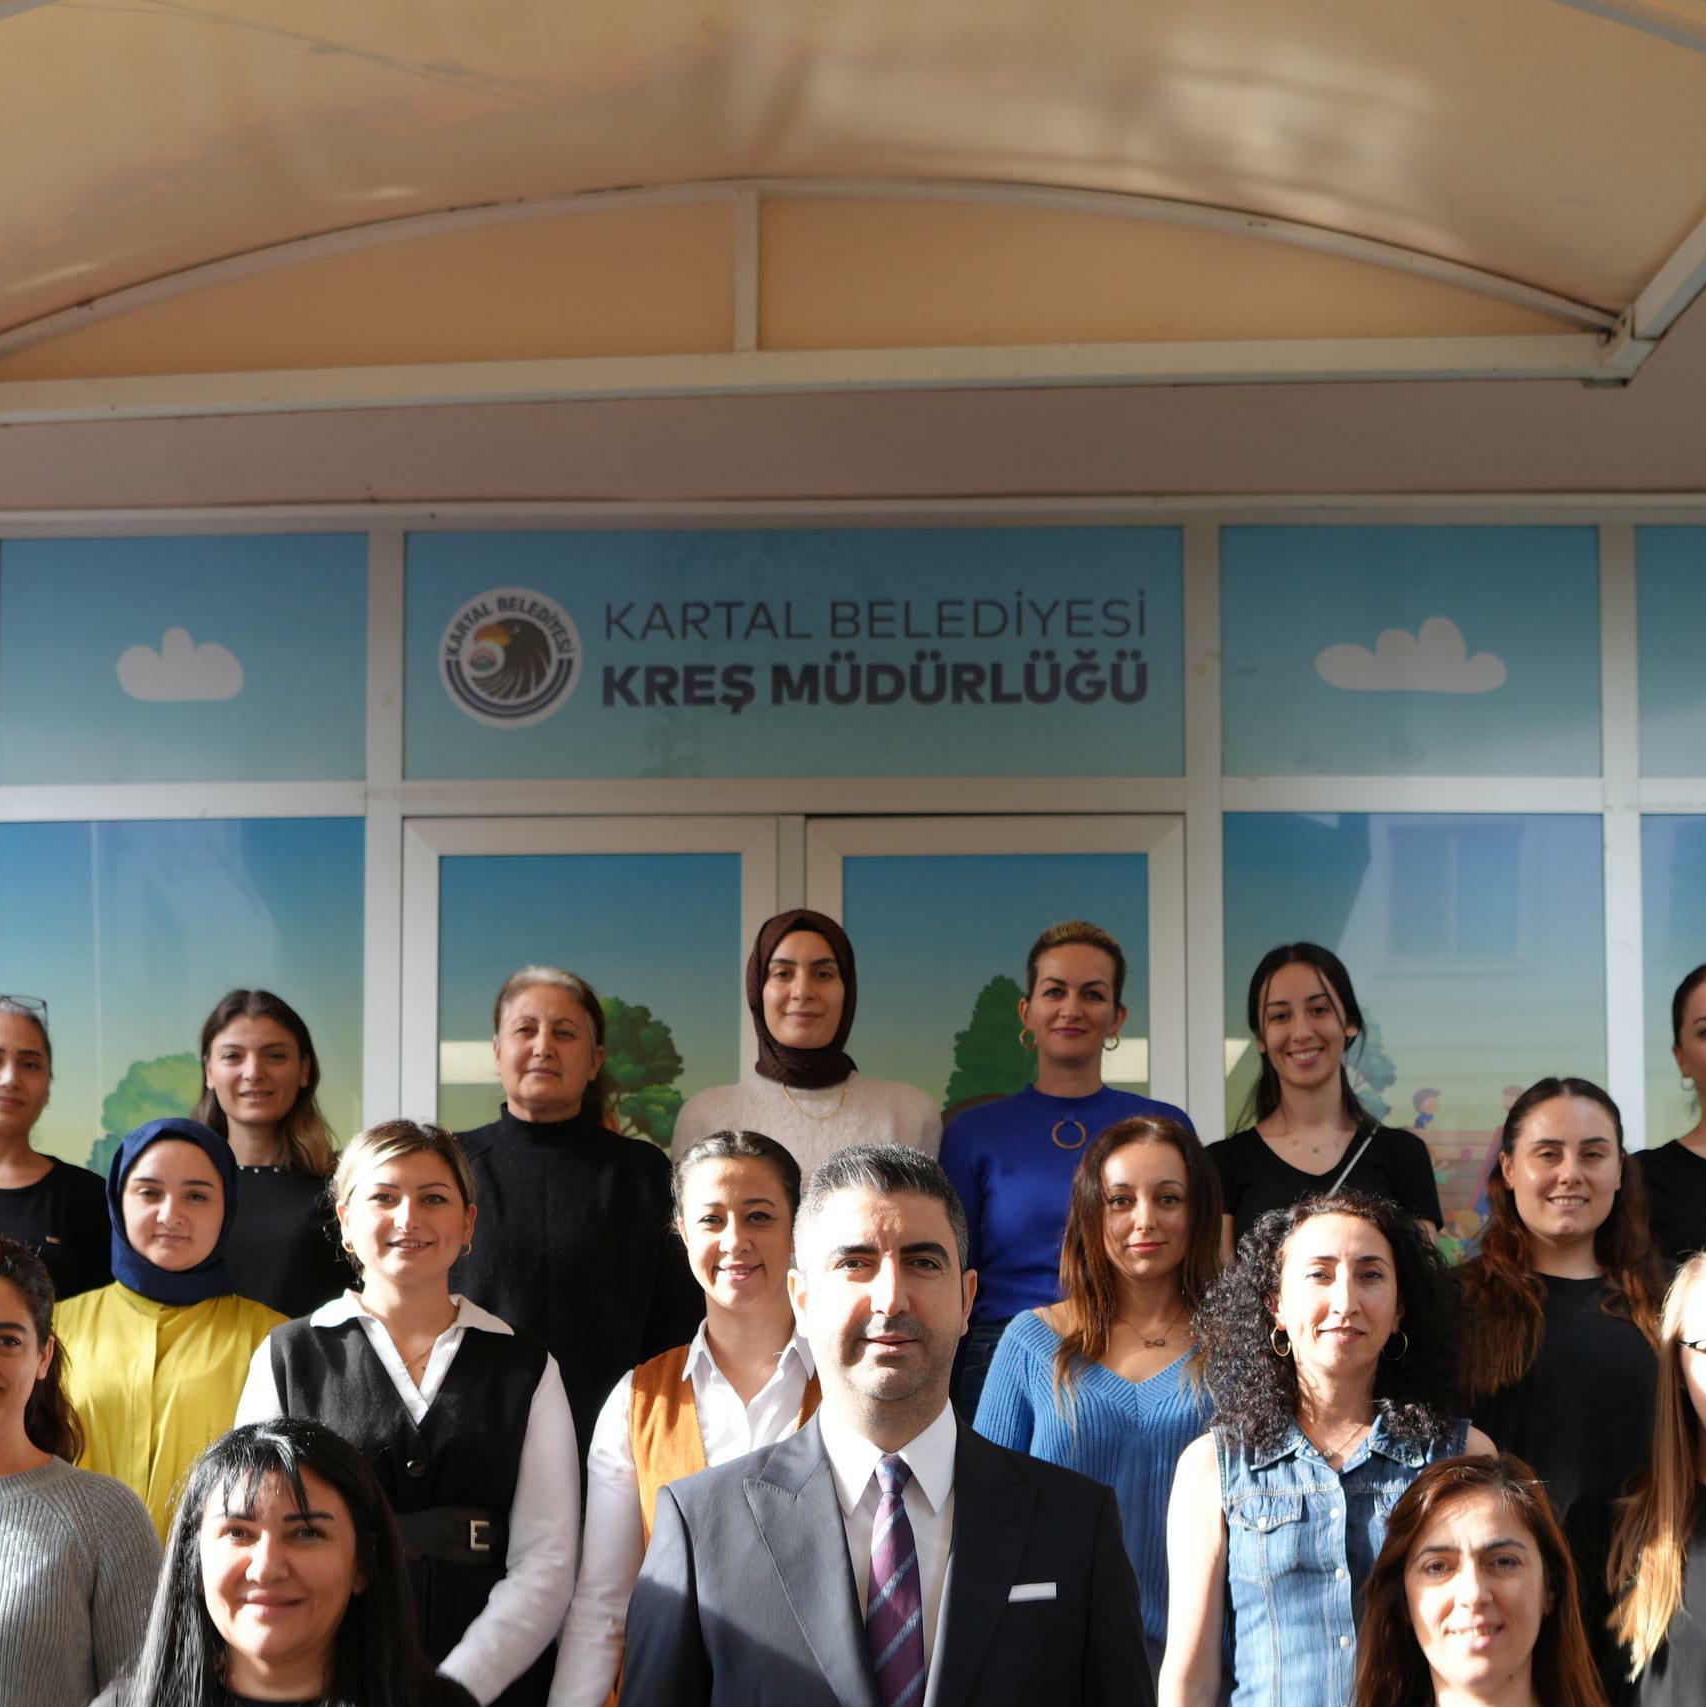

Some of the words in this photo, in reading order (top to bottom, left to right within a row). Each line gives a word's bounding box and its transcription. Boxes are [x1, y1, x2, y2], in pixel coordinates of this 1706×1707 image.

[445, 604, 493, 657] KARTAL
[605, 600, 813, 641] KARTAL
[829, 589, 1147, 640] BELEDİYESİ
[602, 664, 756, 715] KREŞ
[771, 650, 1149, 706] MÜDÜRLÜĞÜ
